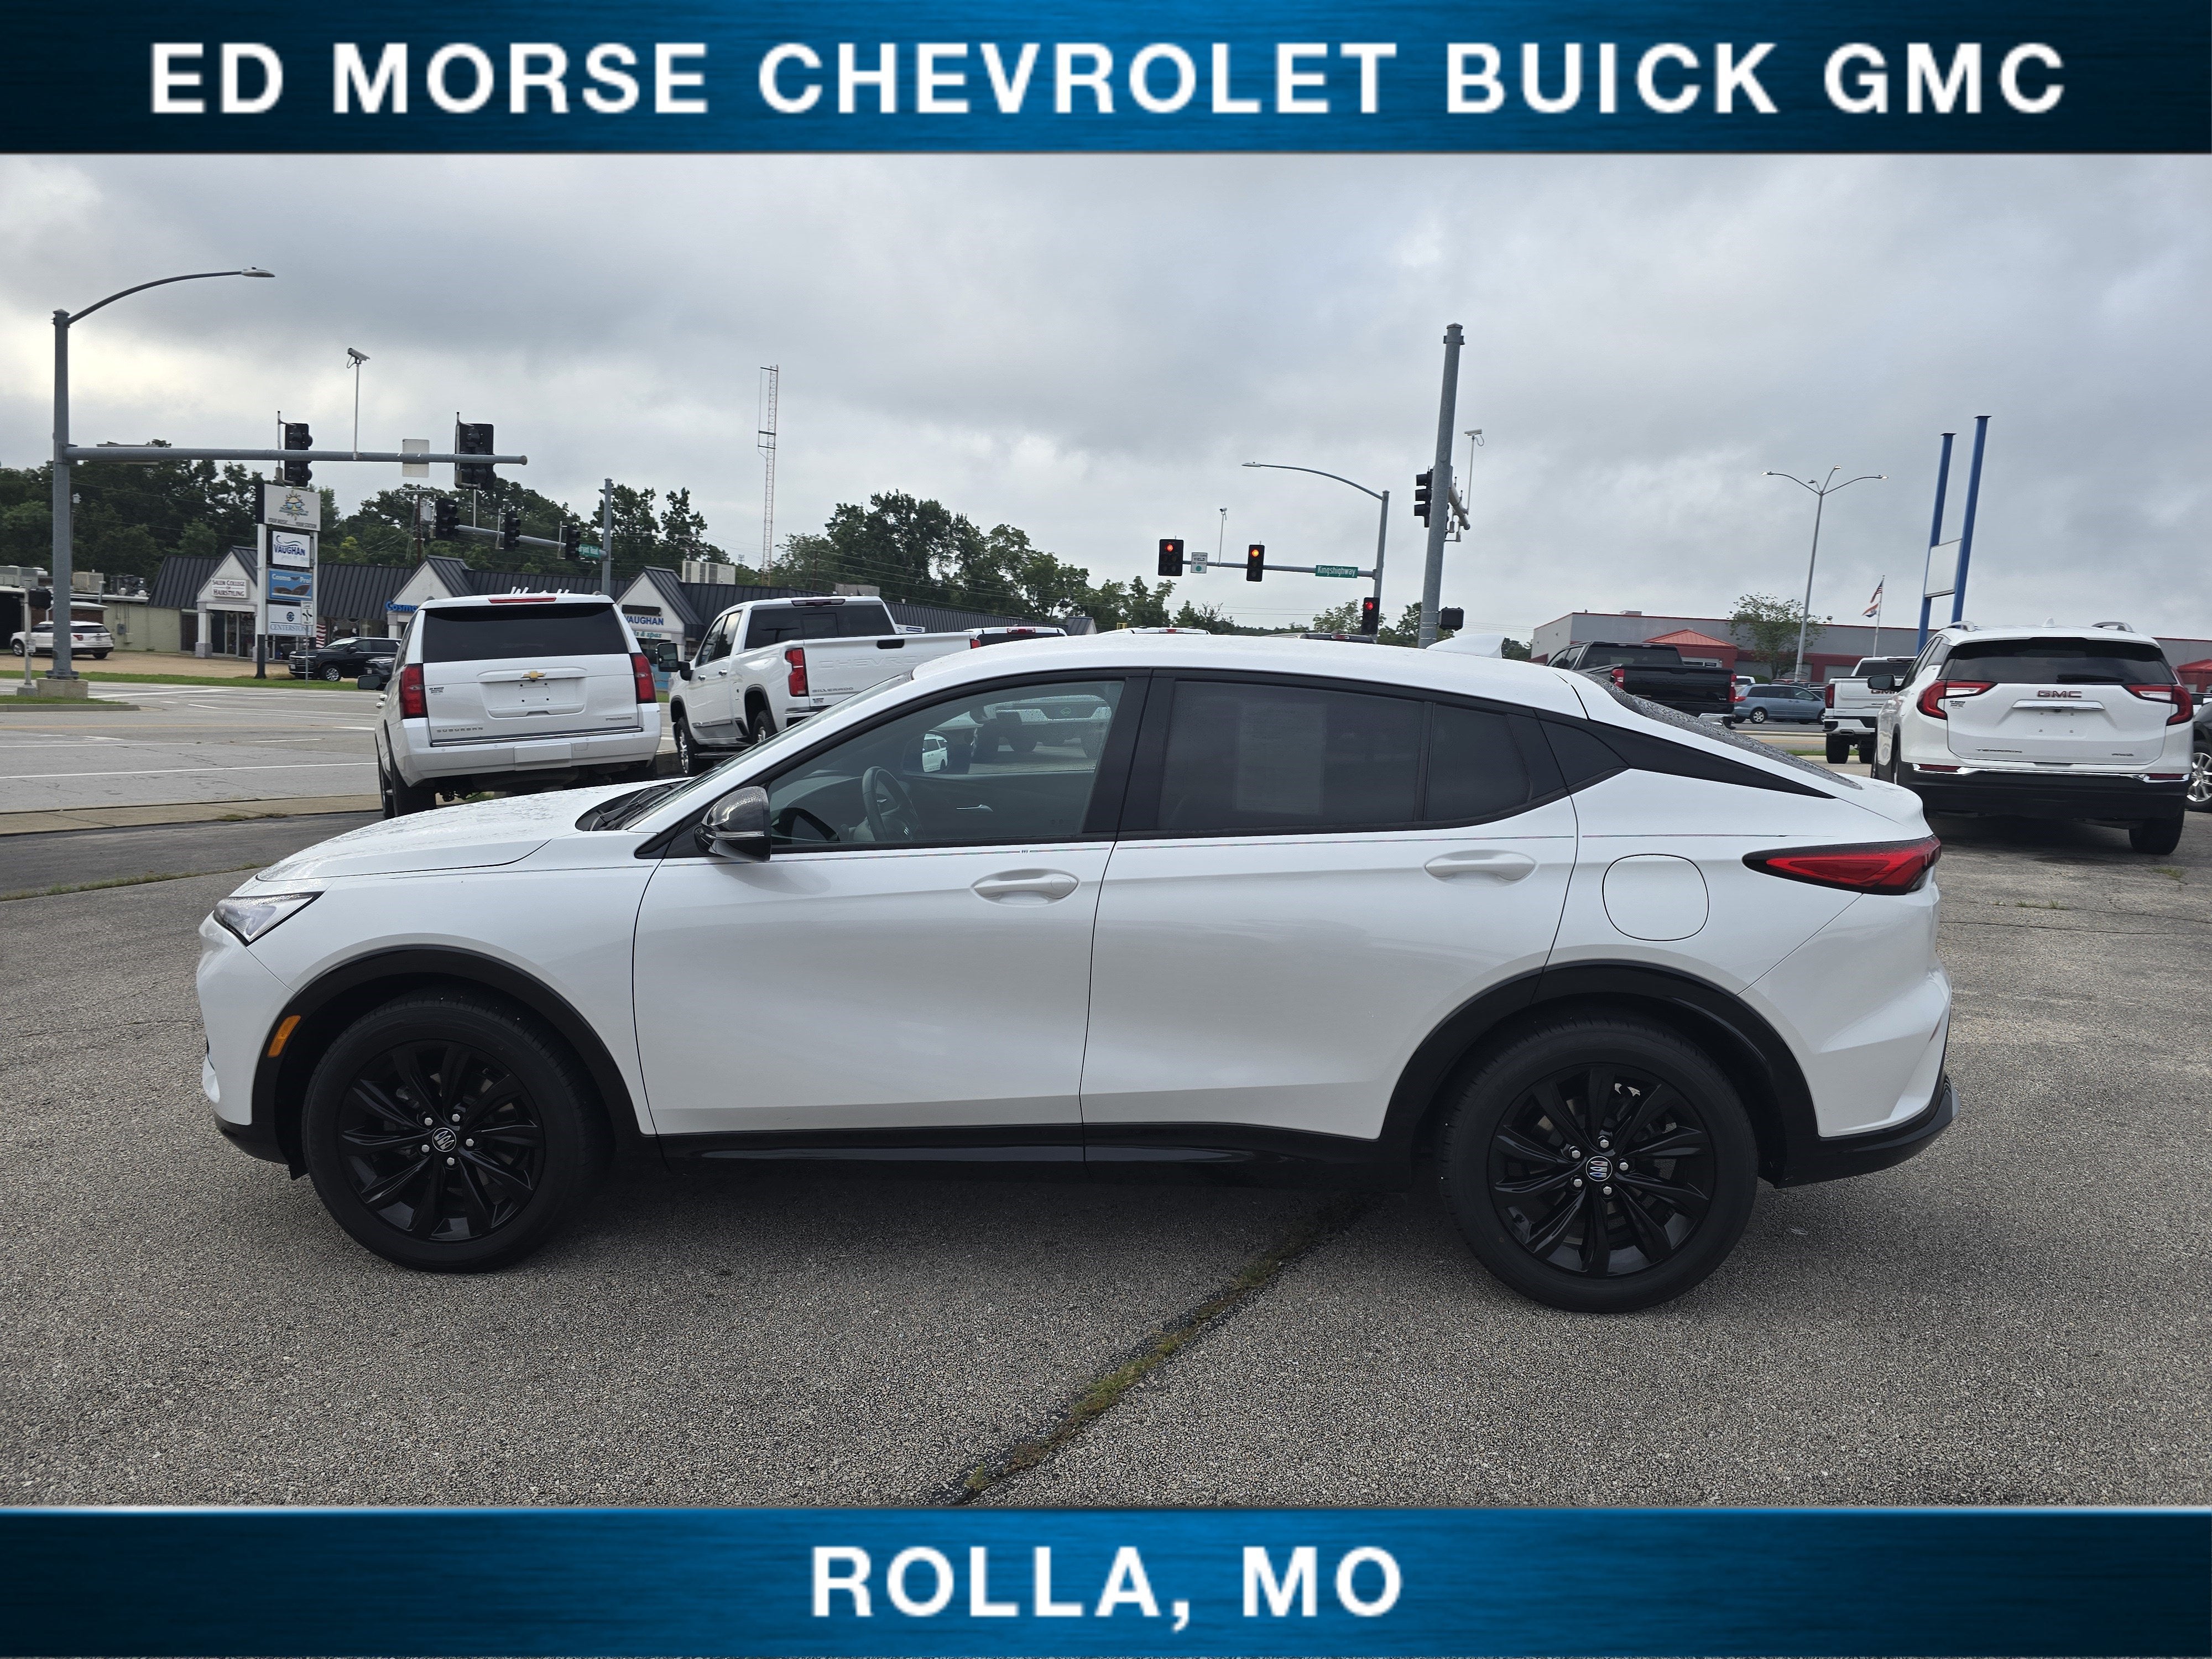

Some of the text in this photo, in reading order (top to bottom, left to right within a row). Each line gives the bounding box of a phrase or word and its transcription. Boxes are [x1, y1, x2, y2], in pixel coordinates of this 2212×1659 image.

[273, 544, 306, 556] VAUGHAN
[1317, 566, 1356, 577] Kingshighway
[269, 624, 311, 632] CENTERSTONE
